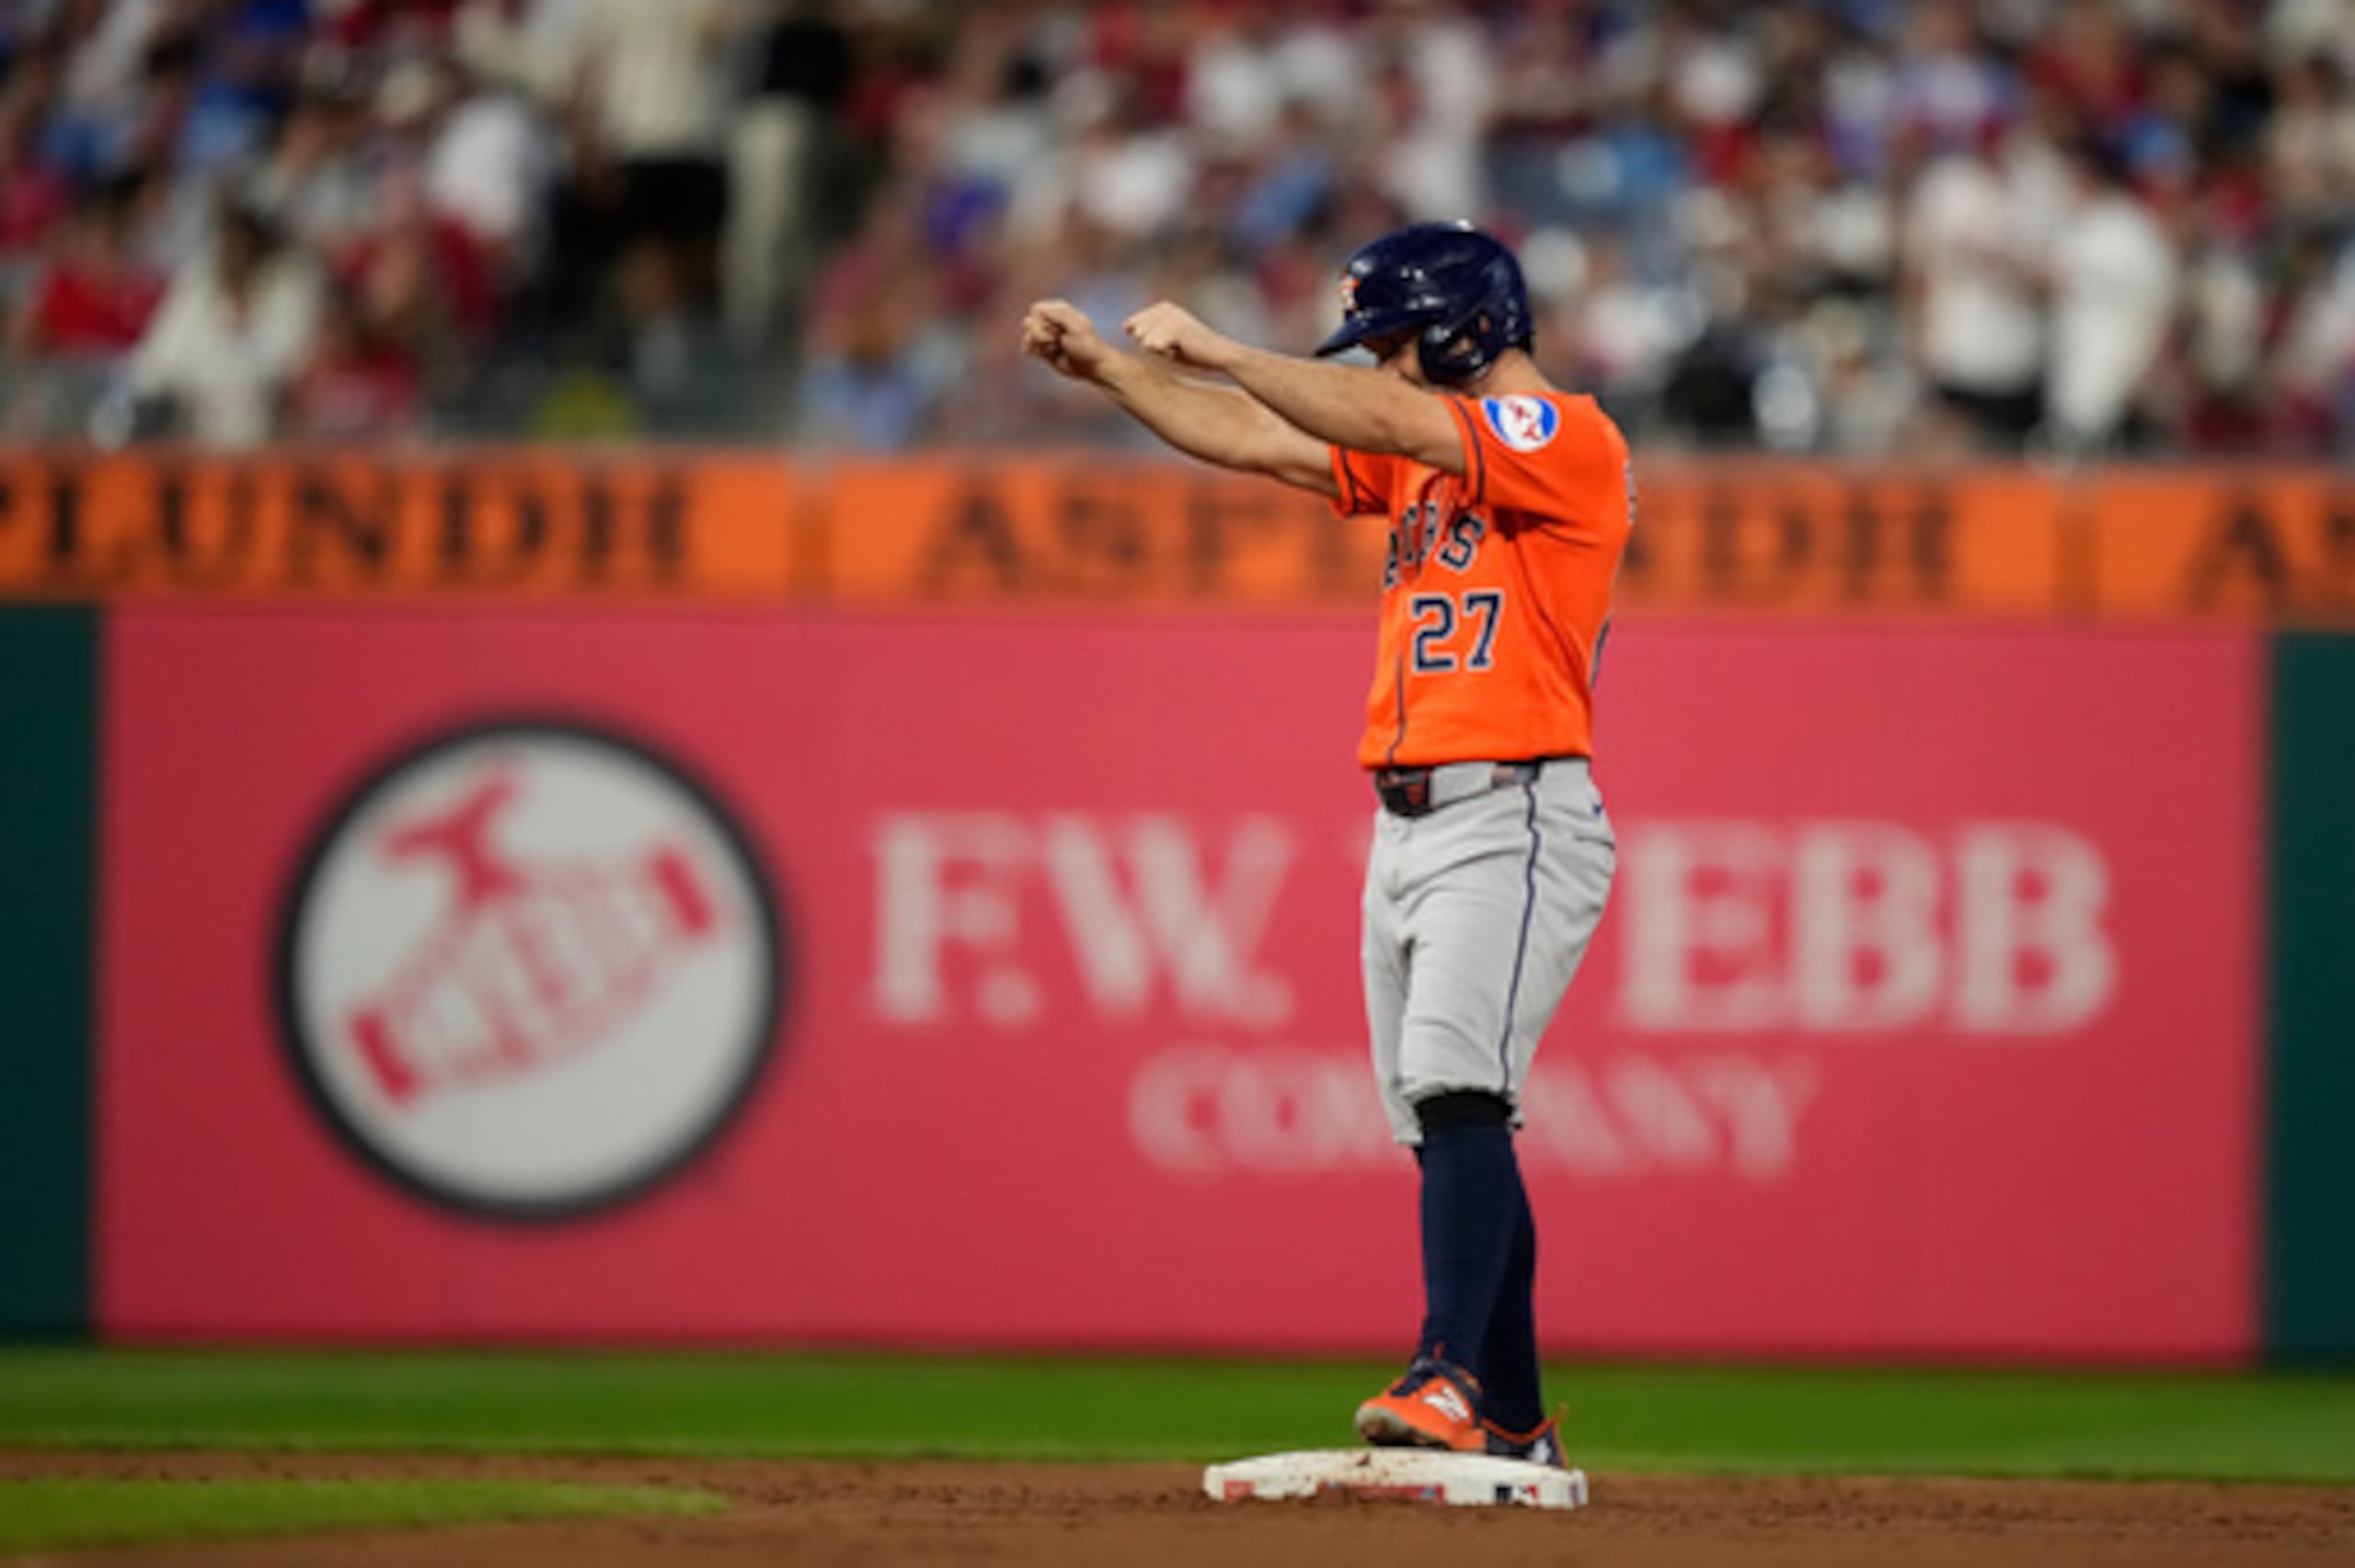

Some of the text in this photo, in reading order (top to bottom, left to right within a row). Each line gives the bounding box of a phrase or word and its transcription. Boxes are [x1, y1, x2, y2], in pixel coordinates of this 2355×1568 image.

[1411, 589, 1504, 673] 27
[1358, 818, 2118, 1034] EBB
[1127, 1048, 1820, 1177] COANY
